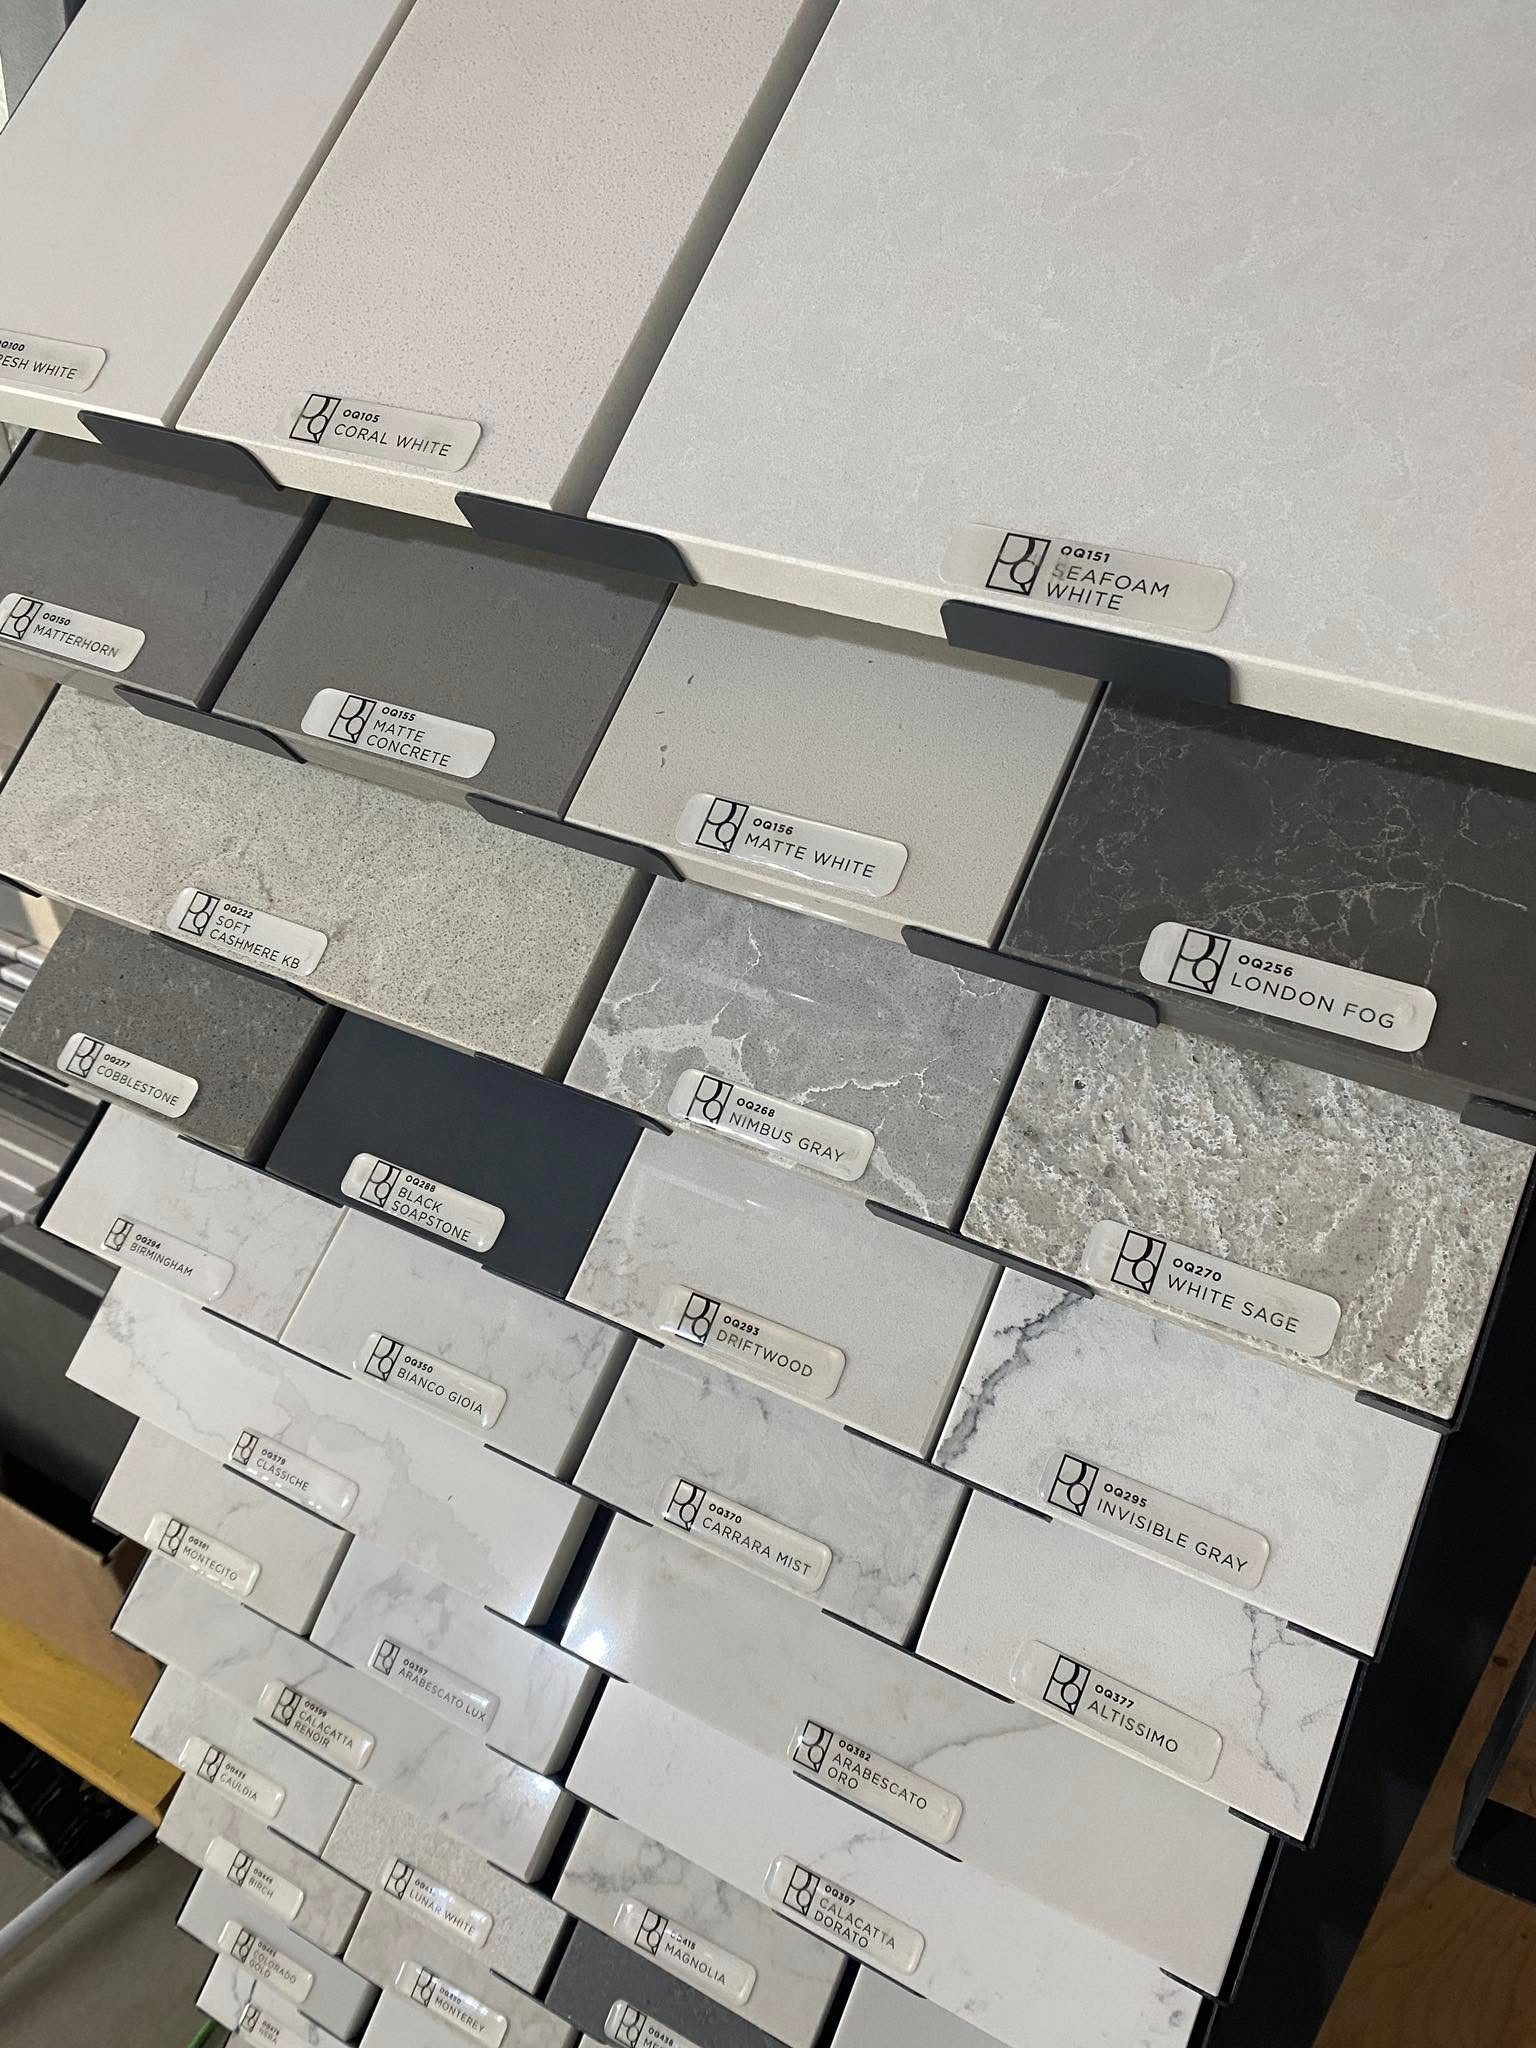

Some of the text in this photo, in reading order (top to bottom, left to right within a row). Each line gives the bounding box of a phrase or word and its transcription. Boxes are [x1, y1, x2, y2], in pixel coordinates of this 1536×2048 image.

[0, 340, 25, 352] Q100
[33, 361, 77, 379] WHITE
[343, 409, 379, 423] OQ105
[334, 423, 451, 457] CORAL WHITE
[1060, 546, 1110, 563] OQ151
[1052, 562, 1170, 599] SEAFOAM
[1047, 583, 1123, 611] WHITE
[42, 612, 71, 626] OQ150
[33, 624, 119, 659] MATTERHORN
[381, 706, 416, 722] OQ155
[372, 721, 426, 743] MATTE
[366, 734, 450, 768] CONCRETE
[753, 817, 794, 835] OQ156
[744, 832, 875, 879] MATTE WHITE
[216, 915, 250, 934] SOFT
[223, 903, 253, 919] OQ222
[209, 928, 301, 970] CASHMERE KB
[1238, 954, 1293, 978] OQ256
[1230, 971, 1395, 1030] LONDON FOG
[103, 1054, 130, 1068] OQ277
[96, 1065, 179, 1106] COBBLESTONE
[736, 1097, 775, 1117] OQ268
[729, 1111, 846, 1163] NIMBUS GRAY
[405, 1175, 436, 1192] OQ288
[398, 1186, 443, 1212] BLACK
[391, 1201, 471, 1242] SOAPSTONE
[135, 1233, 161, 1248] OQ294
[129, 1241, 193, 1277] BIRMINGHAM
[1172, 1257, 1222, 1282] OQ270
[1168, 1274, 1300, 1333] WHITE SAGE
[723, 1315, 760, 1335] OQ293
[404, 1356, 433, 1373] OQ350
[716, 1329, 813, 1377] DRIFTWOOD
[397, 1367, 484, 1415] BIANCO GIOIA
[261, 1448, 286, 1465] OQ379
[256, 1457, 309, 1491] CLASSICHE
[1104, 1483, 1147, 1507] OQ295
[709, 1503, 742, 1524] OQ370
[702, 1517, 811, 1576] CARRARA MIST
[1096, 1498, 1248, 1573] INVISIBLE GRAY
[183, 1546, 238, 1581] MONTECITO
[403, 1658, 428, 1675] OQ387
[398, 1668, 487, 1722] ARABESCATO LUX
[1094, 1684, 1134, 1709] OQ377
[293, 1722, 330, 1748] RENOIR
[299, 1710, 353, 1748] CALACATTA
[1087, 1700, 1178, 1753] ALTISSIMO
[838, 1740, 871, 1762] OQ382
[220, 1773, 257, 1801] CAULDIA
[827, 1767, 859, 1791] ORO
[832, 1753, 927, 1810] ARABESCATO
[248, 1878, 274, 1898] BIRCH
[825, 1885, 855, 1905] OQ397
[409, 1890, 475, 1935] LUNAR WHITE
[820, 1898, 895, 1949] CALACATTA
[814, 1910, 869, 1949] DORATO
[249, 1959, 271, 1979] GOLD
[253, 1951, 296, 1984] COLORADO
[664, 1943, 726, 1985] MAGNOLIA
[434, 1996, 485, 2033] MONTEREY
